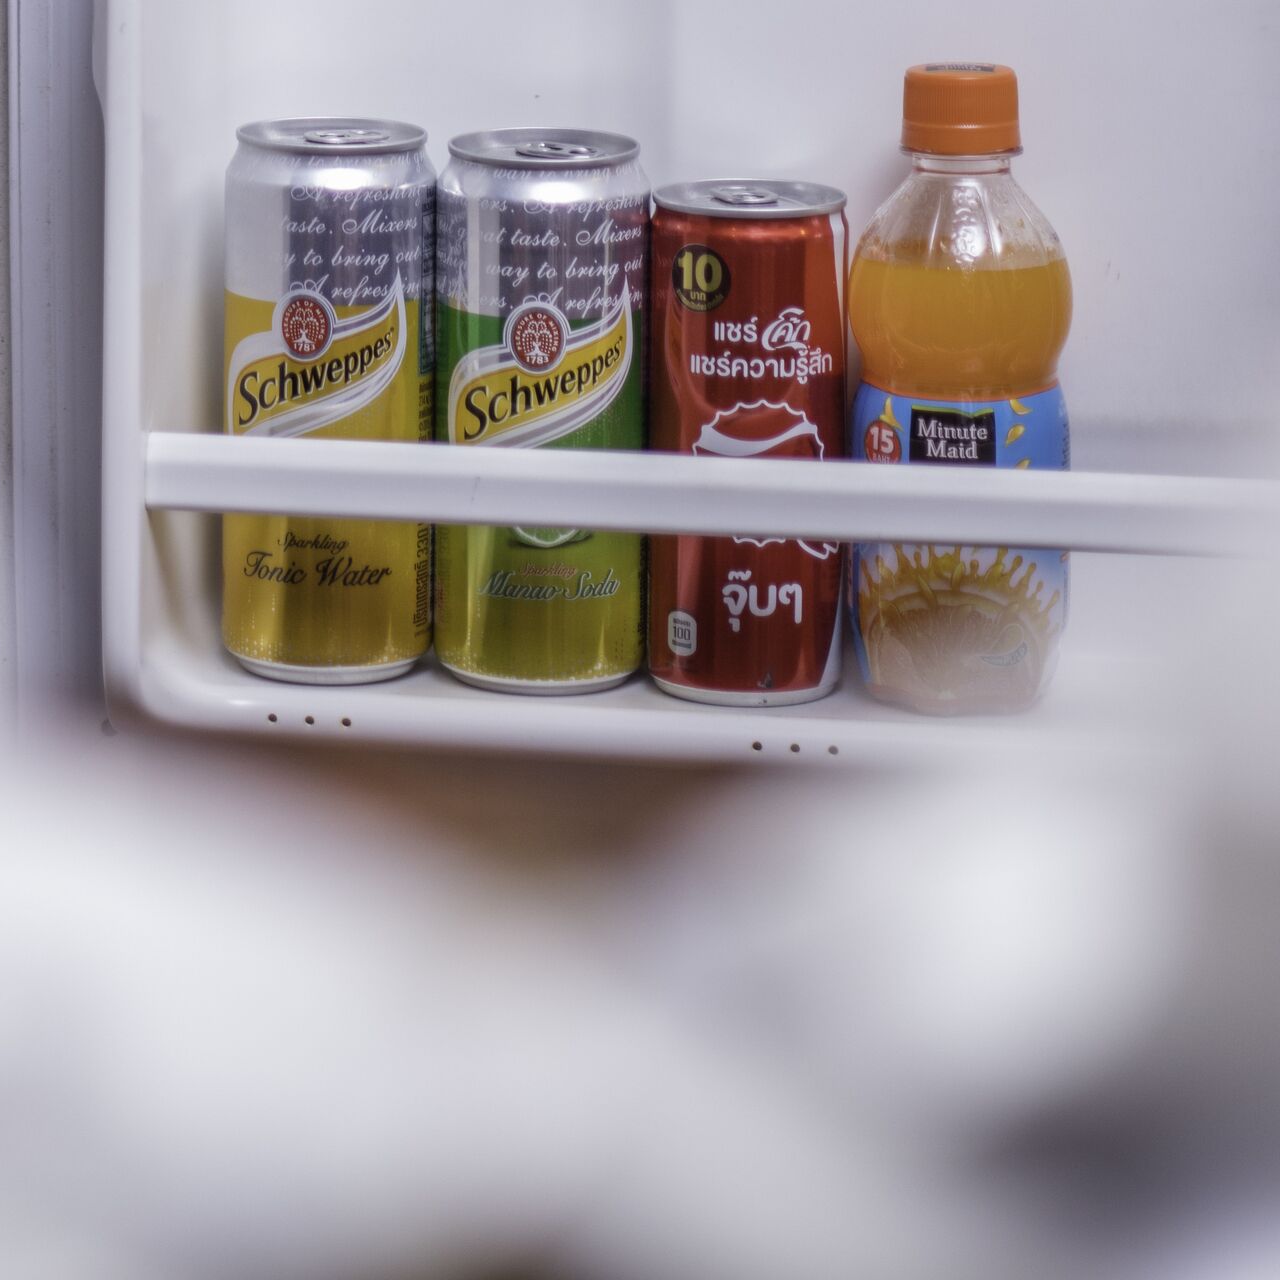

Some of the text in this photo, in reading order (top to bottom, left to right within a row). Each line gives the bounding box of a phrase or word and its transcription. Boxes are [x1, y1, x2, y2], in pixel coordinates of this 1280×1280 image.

[341, 208, 418, 235] Mixers
[510, 227, 568, 248] taste.
[575, 219, 642, 246] Mixers
[303, 248, 324, 267] to
[331, 244, 390, 275] bring
[395, 244, 421, 264] out
[486, 262, 531, 288] way
[536, 261, 558, 277] to
[565, 256, 621, 287] bring
[624, 254, 643, 272] out
[677, 251, 723, 293] 10
[515, 313, 560, 353] PLEASURE OF MIXING
[713, 316, 759, 342] แชร์
[293, 342, 317, 352] 1783
[525, 355, 550, 365] 1783
[690, 345, 833, 385] แชร์ความรู้สึก
[238, 332, 393, 427] Schweppes
[463, 344, 622, 441] Schweppes
[870, 426, 894, 454] 15
[917, 418, 988, 440] Minute
[926, 440, 978, 459] Maid
[277, 531, 349, 555] Sparkling
[243, 550, 393, 586] Tonic Water
[672, 626, 691, 641] 100
